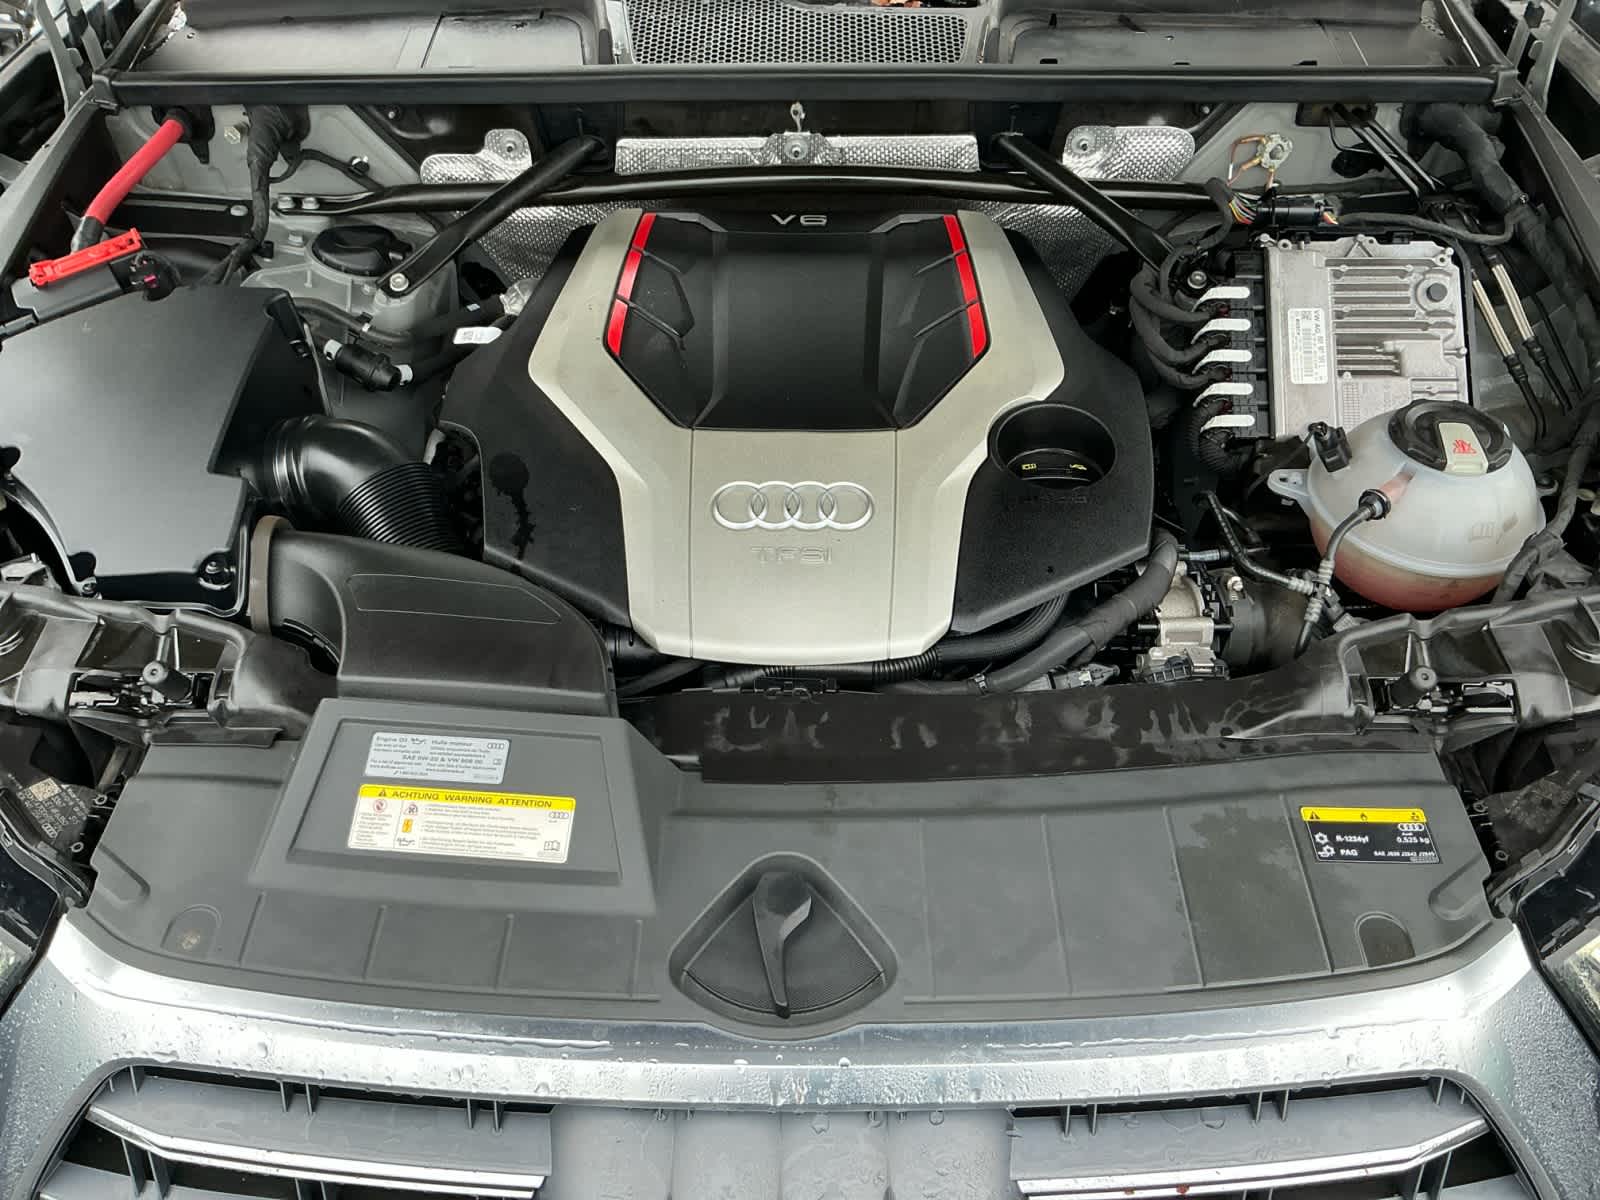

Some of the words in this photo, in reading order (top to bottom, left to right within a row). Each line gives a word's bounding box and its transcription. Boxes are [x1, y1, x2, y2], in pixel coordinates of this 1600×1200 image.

[771, 214, 827, 226] V6
[751, 546, 832, 565] TFSI
[392, 790, 440, 801] ACHTUNG
[444, 794, 493, 805] WARNING
[498, 797, 552, 809] ATTENTION
[1335, 834, 1369, 844] R-1234yf
[1396, 836, 1418, 844] 0.525
[1419, 836, 1430, 845] kg
[1339, 849, 1359, 857] PAG
